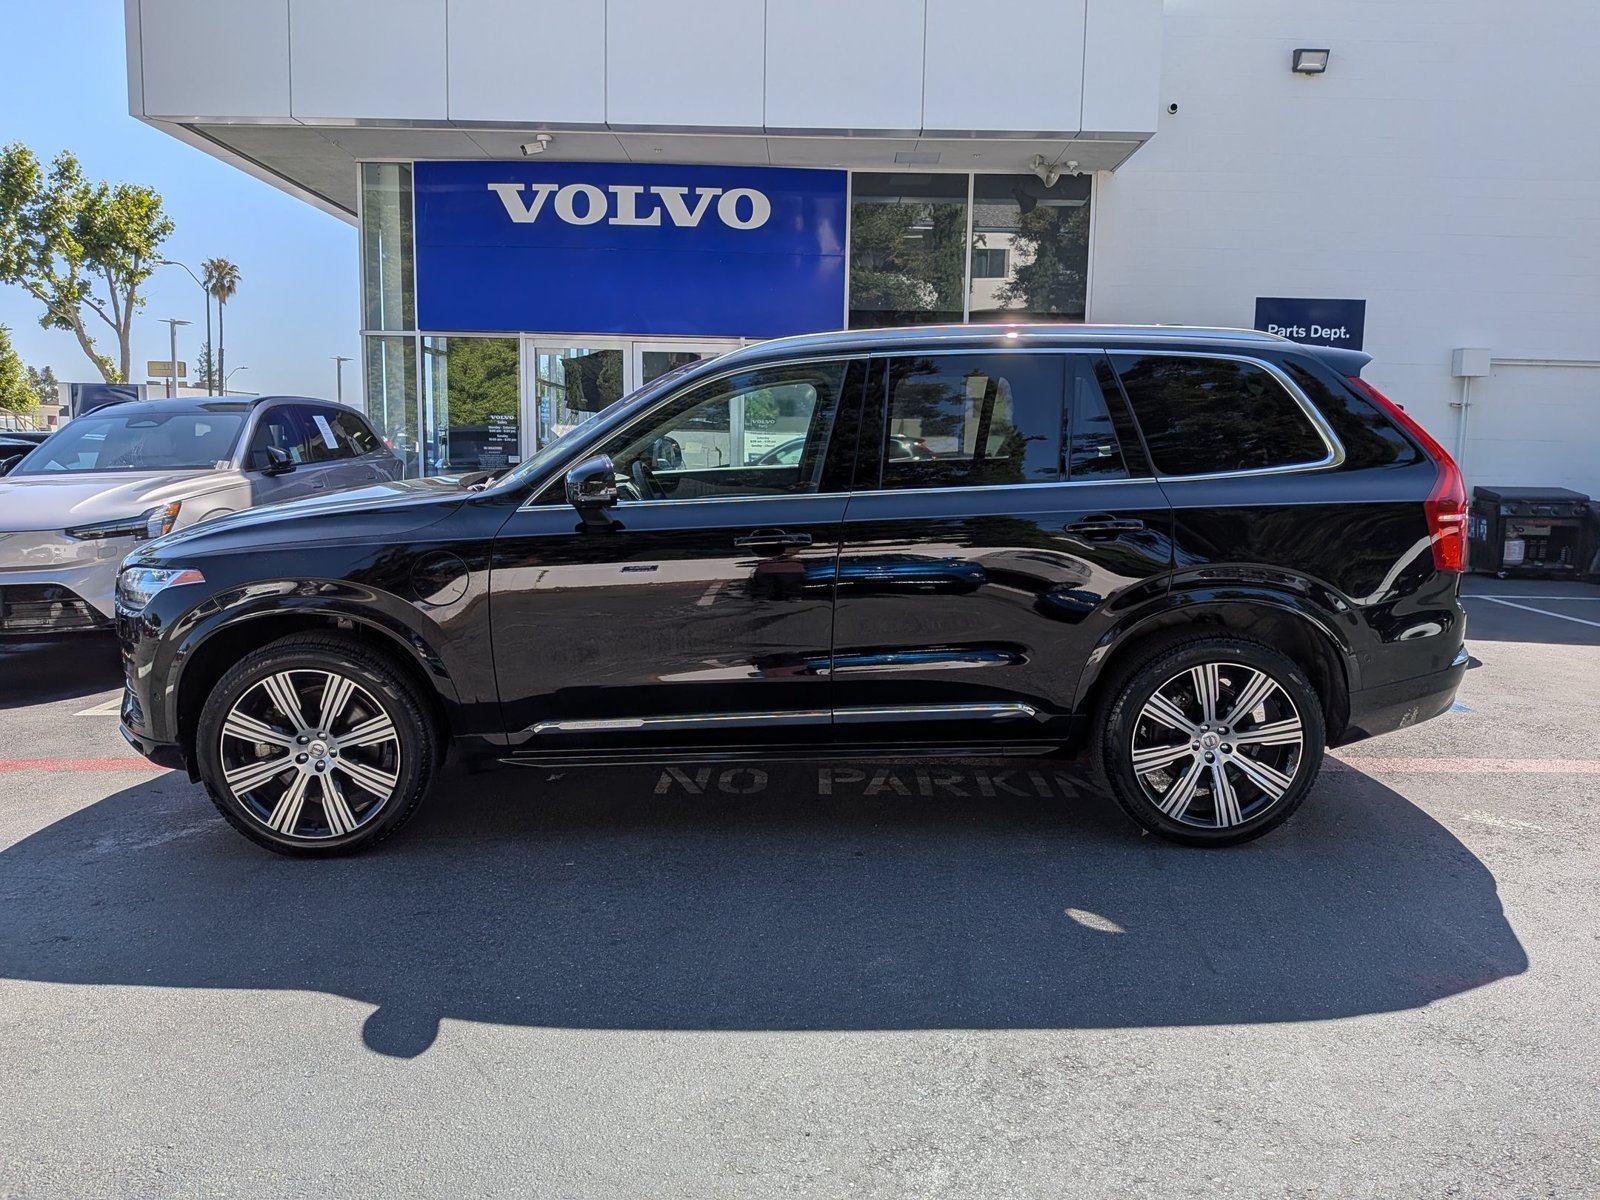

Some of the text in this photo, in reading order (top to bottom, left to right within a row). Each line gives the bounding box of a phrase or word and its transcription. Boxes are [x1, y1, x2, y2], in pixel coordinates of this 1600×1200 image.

[487, 183, 771, 230] VOLVO
[1268, 324, 1350, 341] Parts Dept.
[653, 767, 1108, 798] NO PARKIN
